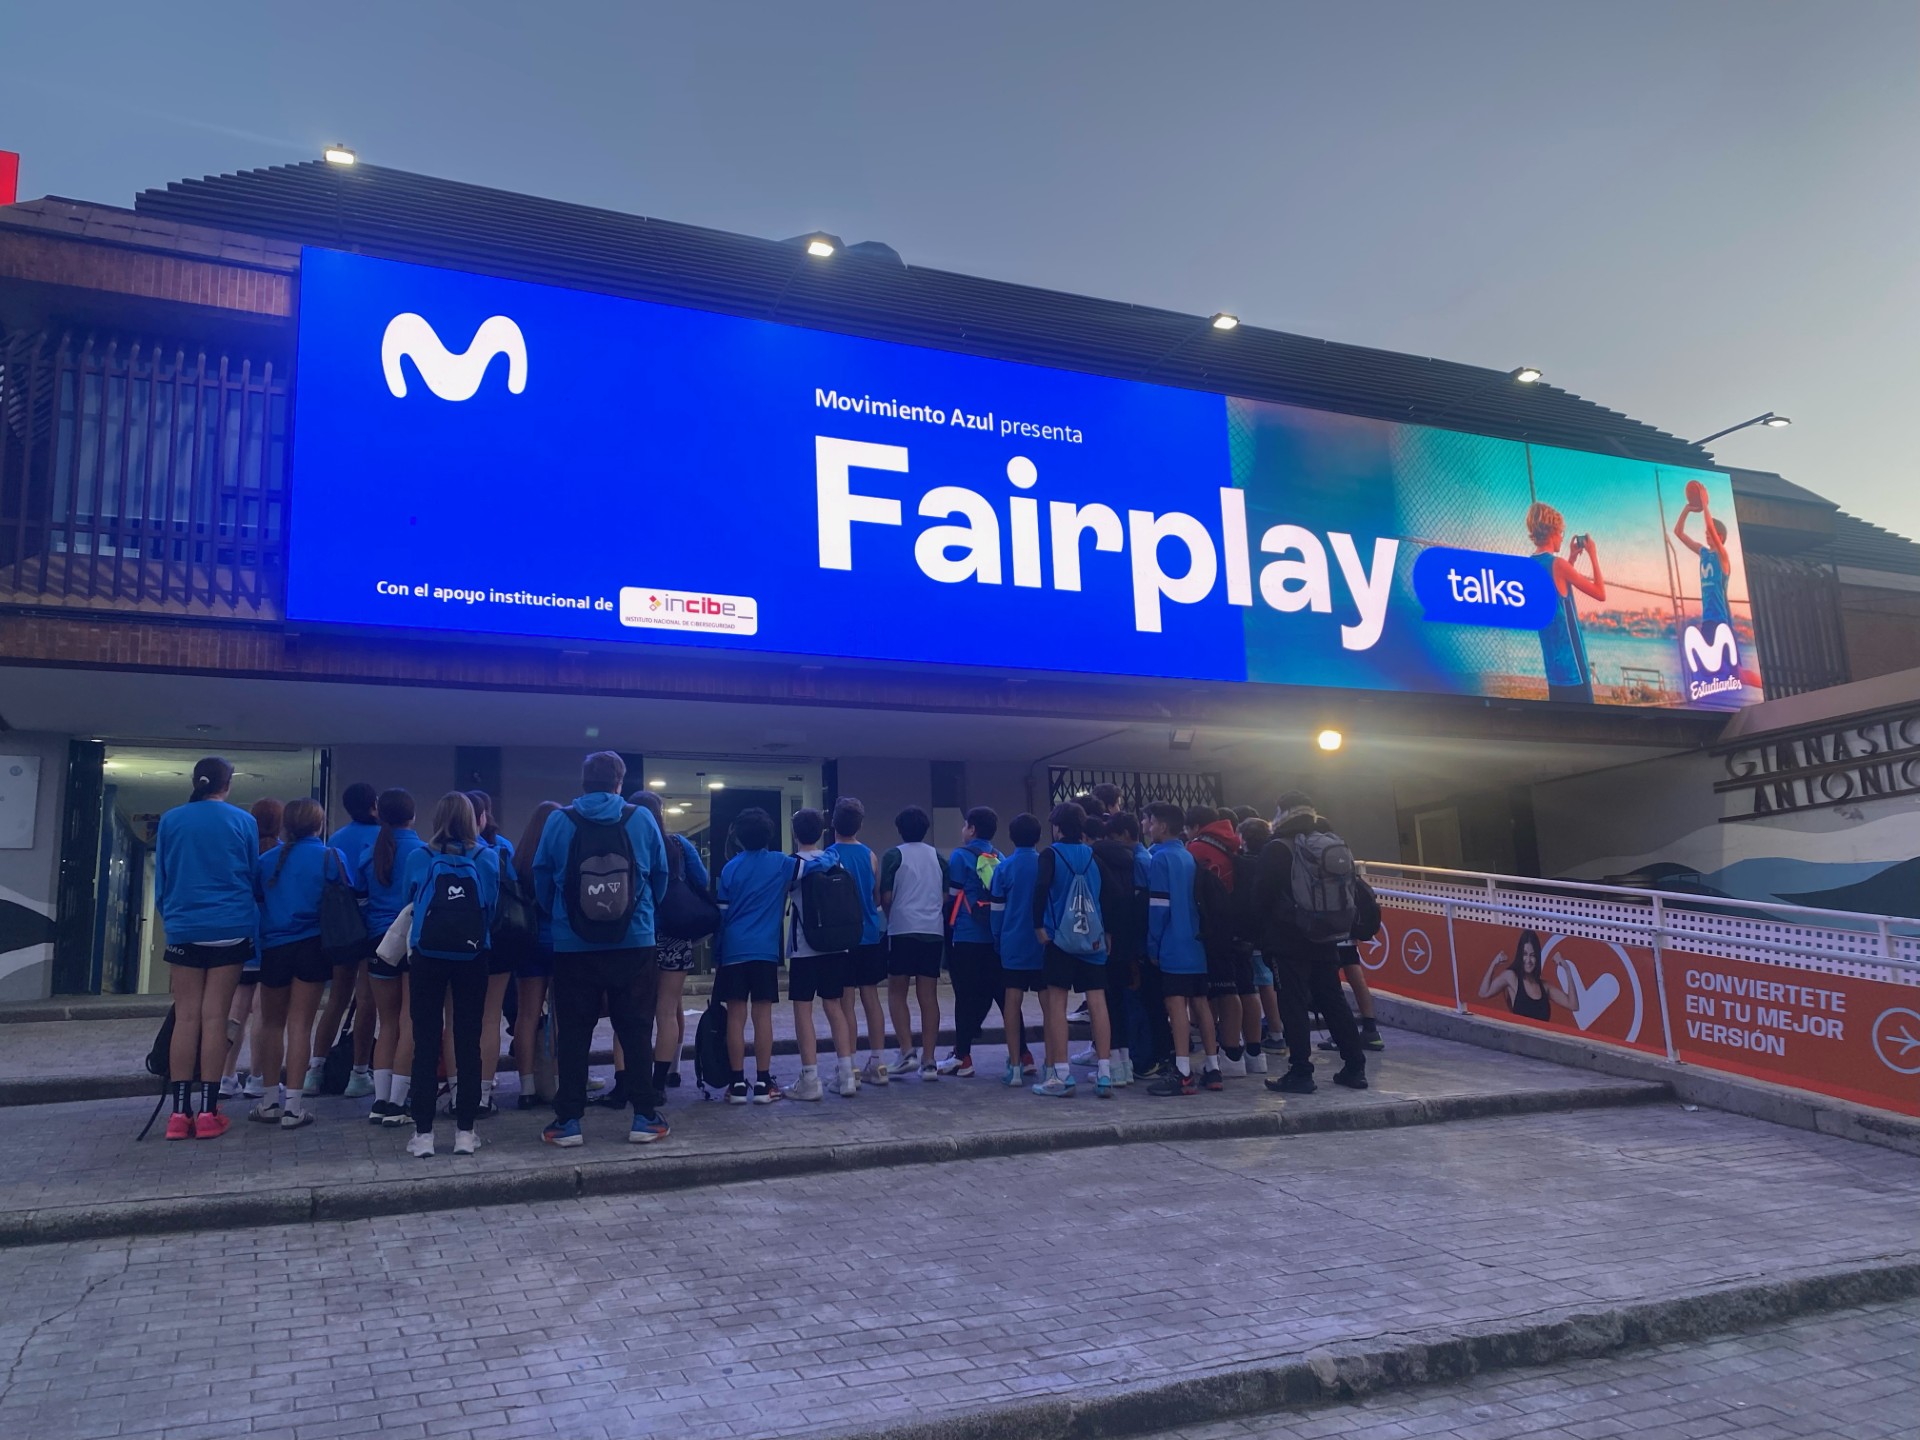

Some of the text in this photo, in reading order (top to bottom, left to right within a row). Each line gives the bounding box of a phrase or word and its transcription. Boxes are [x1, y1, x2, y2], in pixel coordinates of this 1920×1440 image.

[815, 388, 1083, 443] Movimiento Azul presenta
[815, 435, 1399, 651] Fairplay
[376, 580, 614, 611] Con el apoyo institucional de
[1447, 568, 1526, 607] talks
[625, 616, 653, 624] INSTITUTO
[653, 618, 680, 627] NACIONAL
[690, 620, 736, 630] CIBERSEGURIDAD
[1690, 675, 1742, 700] Estudiantes
[1685, 969, 1846, 1013] CONVIERTETE
[1686, 994, 1844, 1041] EN TU MEJOR
[1686, 1019, 1785, 1057] VERSIÓN
